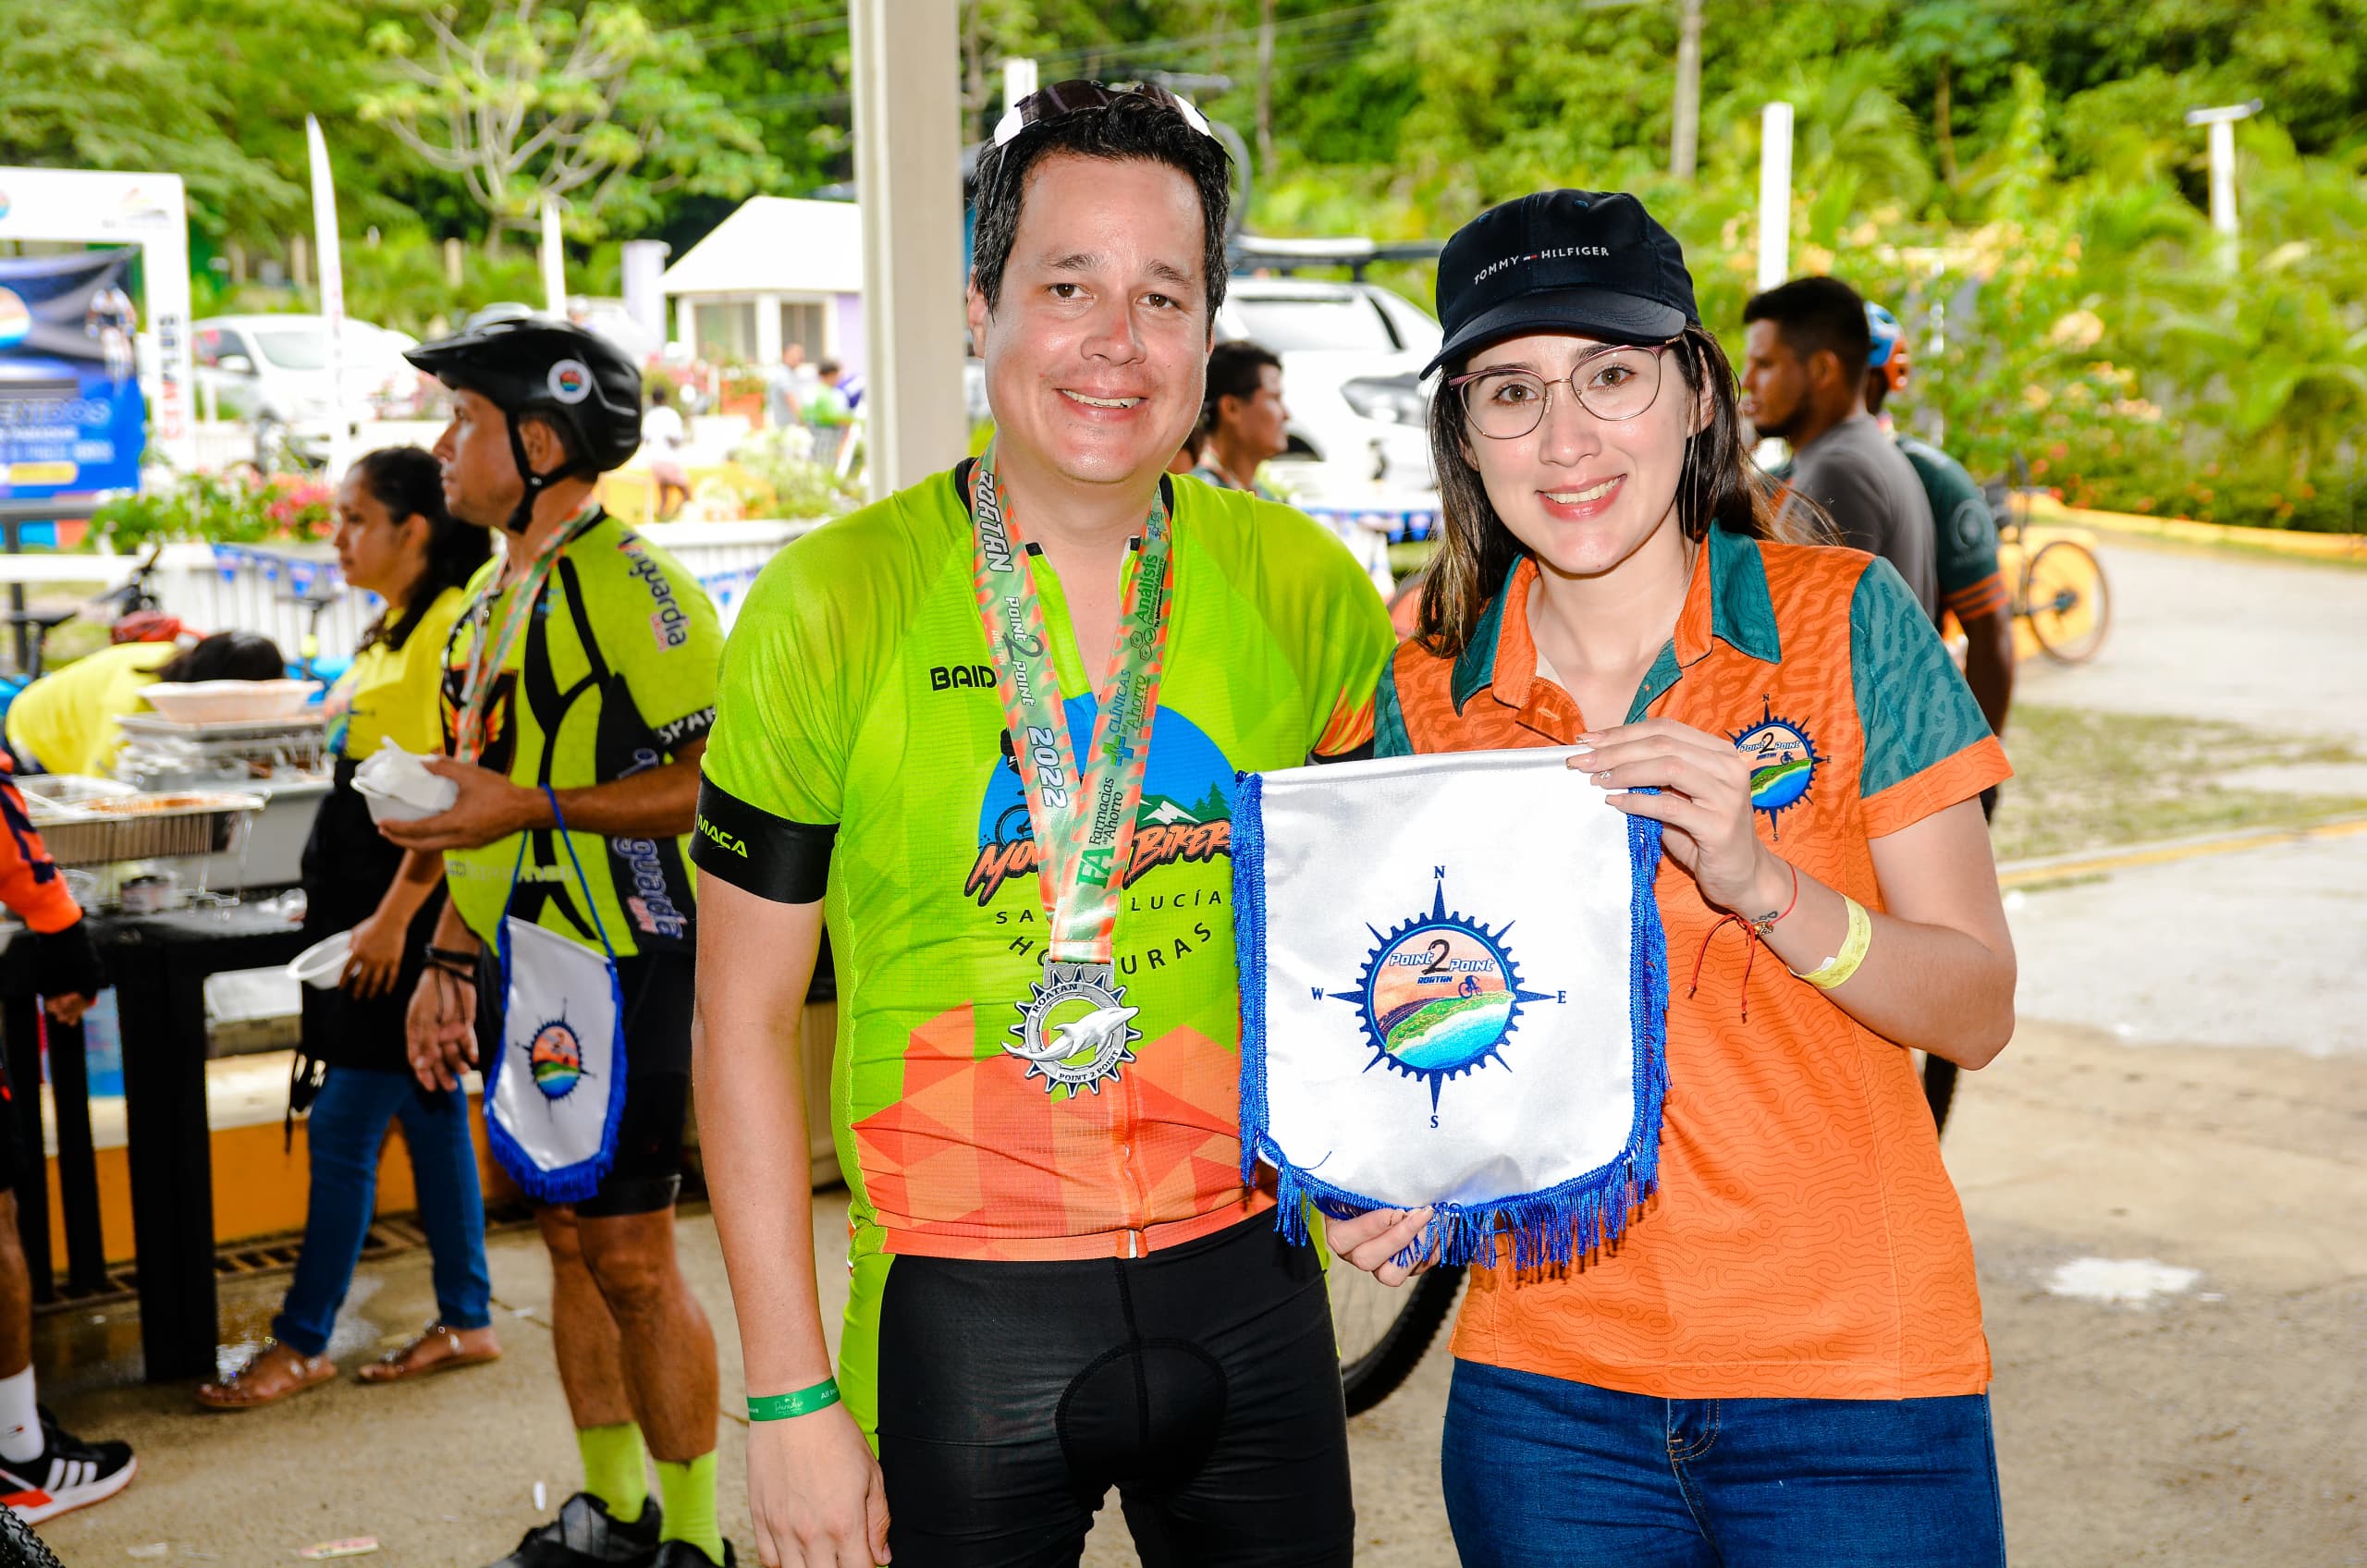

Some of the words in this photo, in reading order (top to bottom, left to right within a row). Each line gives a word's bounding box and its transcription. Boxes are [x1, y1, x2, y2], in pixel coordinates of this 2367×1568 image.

[1474, 255, 1519, 286] TOMMY
[1541, 246, 1609, 260] HILFIGER
[975, 470, 1014, 572] ROATAN
[617, 531, 690, 646] Vguardia
[1134, 555, 1158, 623] Análisis
[1002, 633, 1044, 662] 2
[1110, 669, 1131, 733] CLÍNICAS
[1760, 732, 1774, 754] 2
[1027, 726, 1067, 808] 2022
[1089, 777, 1114, 845] Farmacias
[1105, 791, 1123, 840] Ahorro
[697, 814, 748, 859] MACA
[1122, 817, 1232, 890] BIKER
[1075, 846, 1115, 889] FA
[1433, 865, 1446, 879] N
[1131, 889, 1222, 913] LUCÍA
[1009, 922, 1211, 975] HURAS
[1421, 938, 1451, 975] 2
[1033, 983, 1078, 1013] ROATAN
[1311, 986, 1325, 1000] W
[1417, 975, 1453, 985] ROATAN
[1557, 990, 1566, 1004] E
[1059, 1072, 1088, 1082] POINT
[1097, 1049, 1120, 1074] POINT
[1429, 1115, 1440, 1129] S
